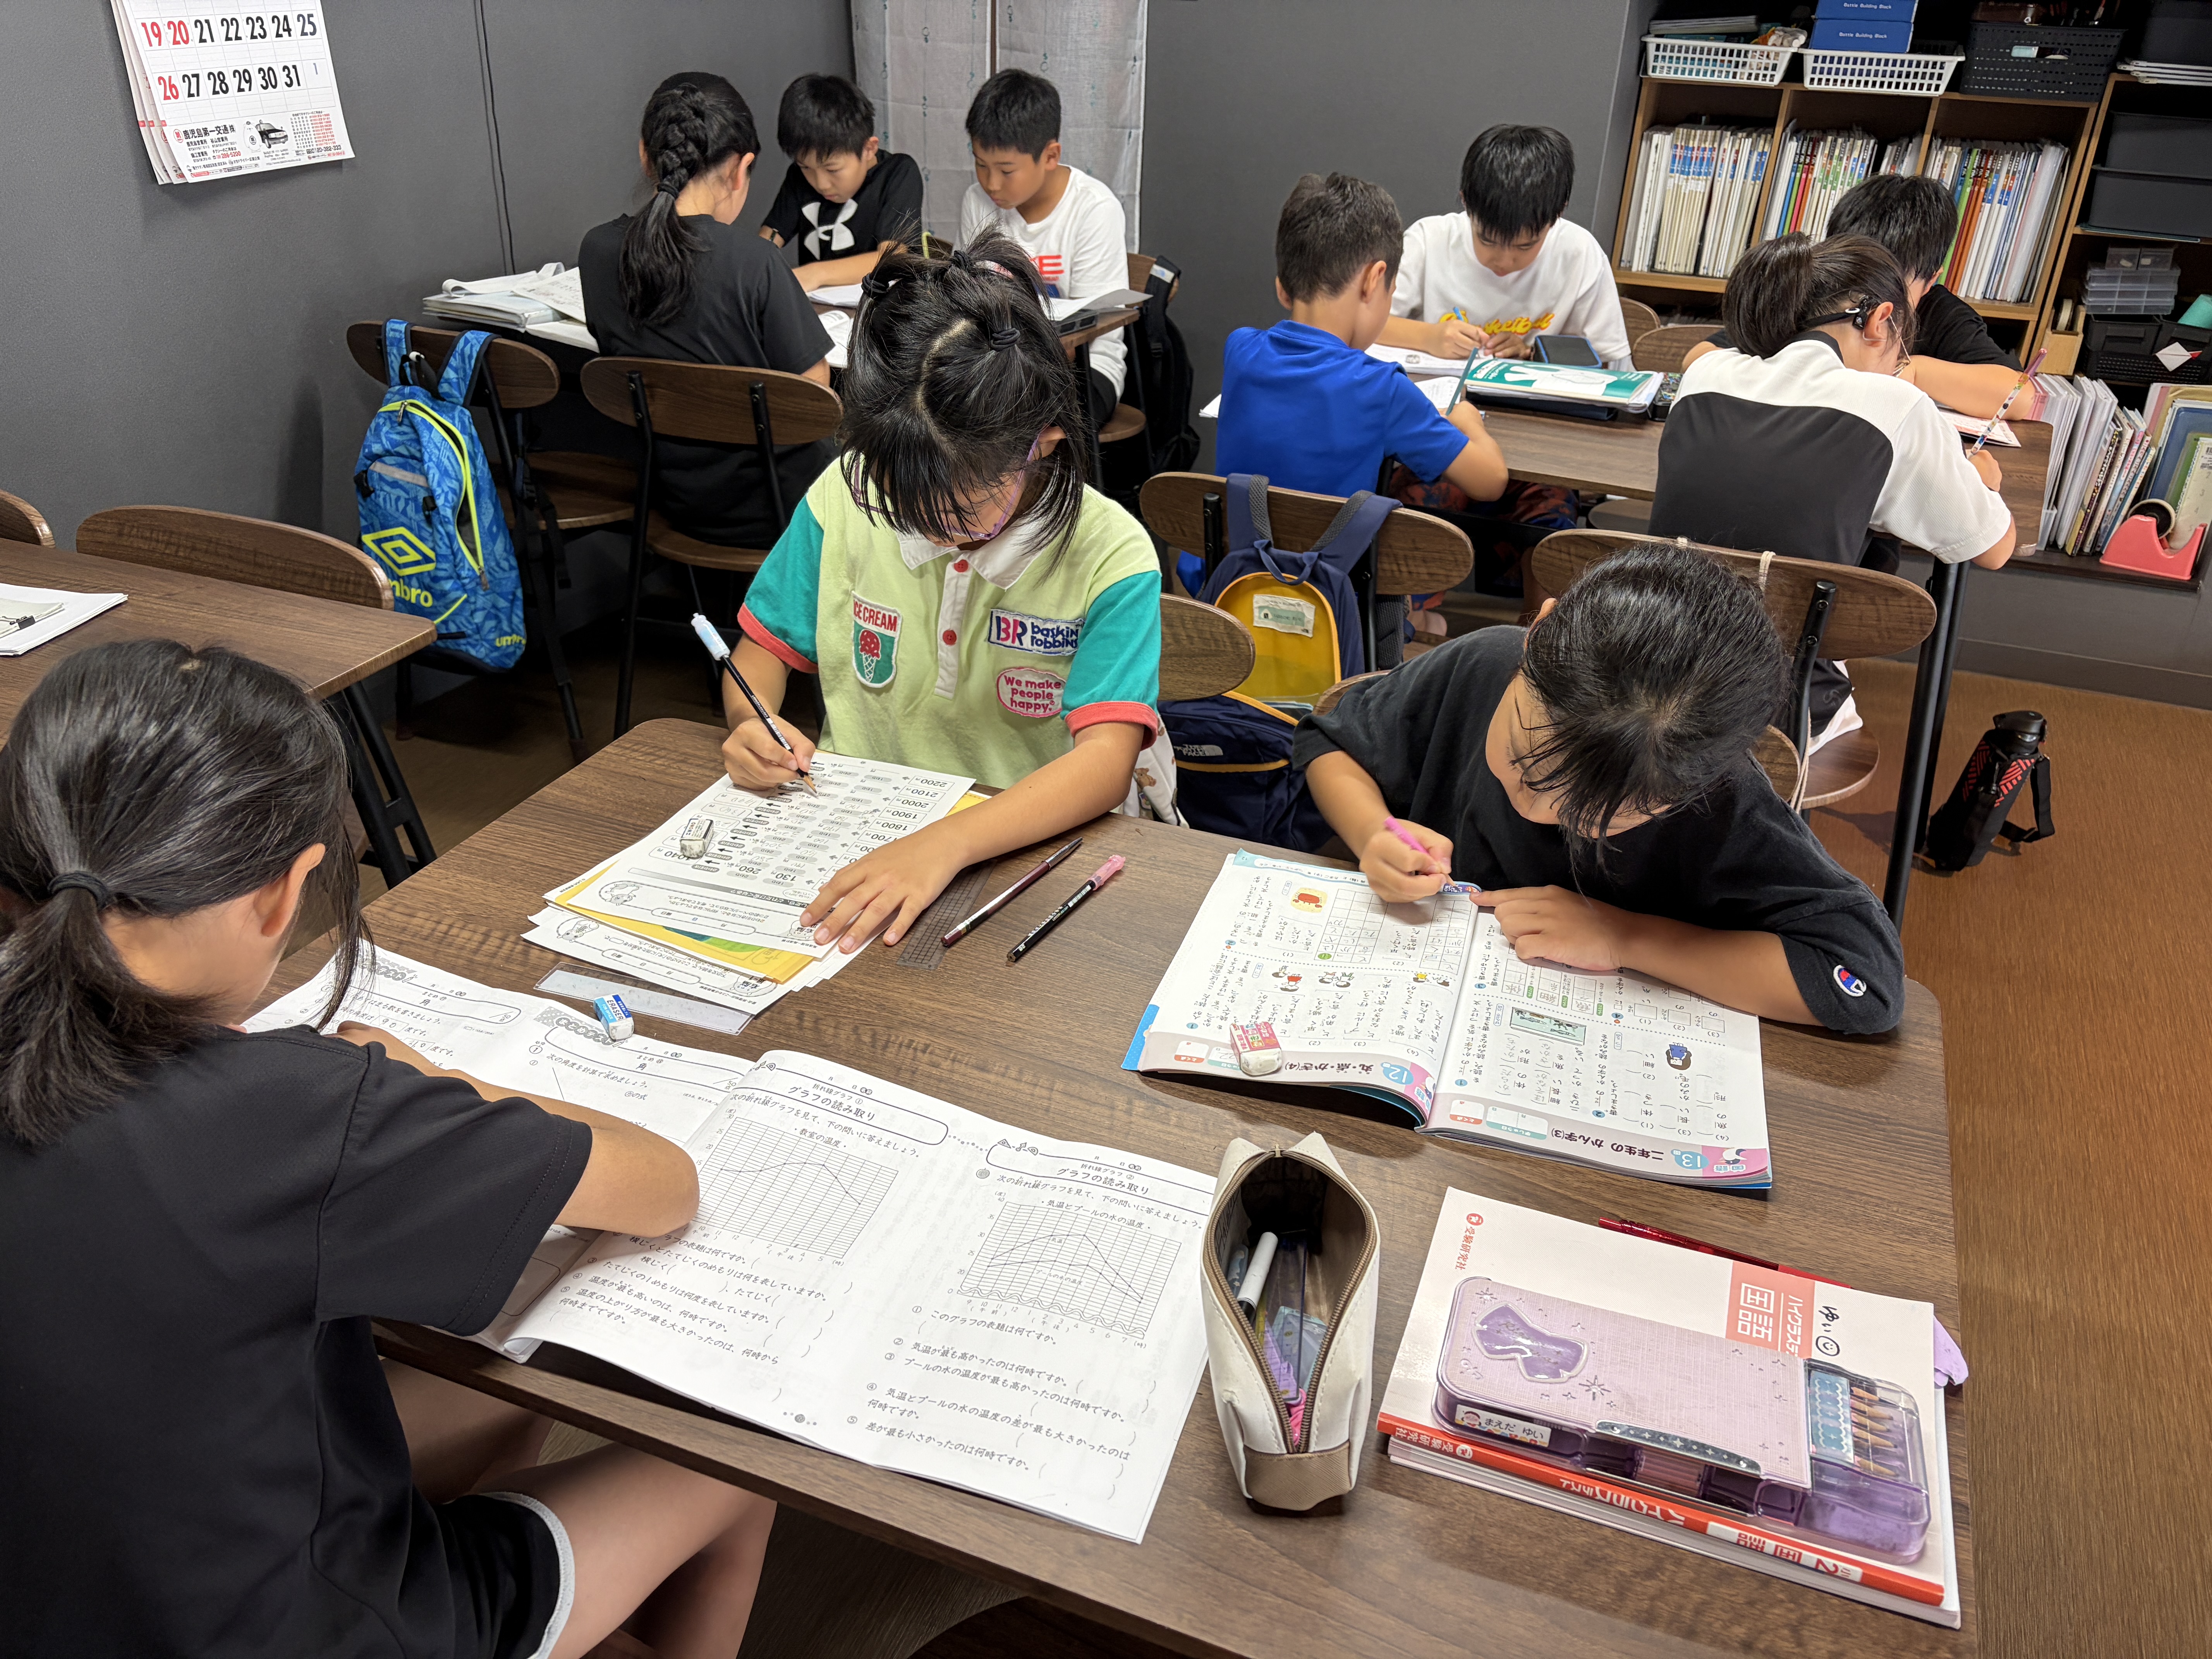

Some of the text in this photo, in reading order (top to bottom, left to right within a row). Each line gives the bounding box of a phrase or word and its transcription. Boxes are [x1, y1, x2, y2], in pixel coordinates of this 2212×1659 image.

[141, 14, 316, 46] 19 20 21 22 23 24 25
[158, 63, 318, 101] 26 27 28 29 30 31 1
[388, 577, 433, 607] mbro
[863, 606, 897, 632] CREAM
[1032, 621, 1077, 641] baskin
[1030, 635, 1077, 648] robbins
[1004, 675, 1061, 689] We make
[1011, 688, 1053, 701] people
[905, 787, 939, 798] 2100円
[915, 778, 948, 787] 2200円
[886, 809, 917, 819] 1900円
[896, 798, 929, 808] 2000円
[876, 821, 908, 831] 1800円
[735, 863, 763, 874] 260円
[770, 871, 798, 881] 130円
[668, 895, 769, 919] 2つ前のページにならって、考えてみましょう。
[669, 900, 765, 923] 2わり引きになると、何円になるでしょうか。
[606, 1000, 624, 1022] ERASER
[554, 1017, 615, 1046] まとめテスト
[1462, 1036, 1474, 1057] かん字に
[546, 1053, 647, 1088] 次の角度を計算で求めましょう。
[1387, 1066, 1409, 1082] 12
[788, 1085, 876, 1121] グラフの読み取り
[813, 1083, 853, 1100] 折れ線グラフ
[730, 1093, 919, 1158] 次の折れ線グラフを見て、下の問いに答えましょう。
[1550, 1128, 1664, 1160] 二年生の かん字(3)
[1080, 1163, 1122, 1177] 折れ線グラフ
[1680, 1153, 1702, 1168] 13
[1056, 1168, 1149, 1195] グラフの読み取り
[996, 1174, 1202, 1230] 次の折れ線グラフを見て、下の問いに答えましょう。
[665, 1234, 745, 1264] ラフの表題は何ですか。
[1455, 1226, 1475, 1271] 受験研究社
[629, 1236, 826, 1301] 横じくとたてじくのめもりは何を表していますか。
[1035, 1269, 1083, 1286] プールの水の温度
[588, 1275, 727, 1333] 温度が最も高いのは、何時ですか。
[603, 1261, 769, 1324] たてじくの1めもりは何度を表していますか。
[559, 1298, 625, 1324] 何時までですか。
[1736, 1282, 1775, 1342] 国語
[576, 1288, 778, 1365] 温度の上がり方が最も大きかったのは、何時から
[931, 1311, 1058, 1345] このグラフの表題は何ですか。
[912, 1341, 1068, 1387] 気温が最も高かったのは何時ですか。
[904, 1357, 1126, 1423] プールの水の温度が最も高かったのは何時ですか。
[867, 1398, 920, 1419] 何時ですか。
[885, 1387, 1131, 1461] 気温とプールの水の温度の差が最も大きかったのは
[1484, 1417, 1544, 1440] まえだ ゆい
[865, 1421, 1029, 1471] 差が最も小さかったのは何時ですか。
[1395, 1427, 1454, 1453] 受験研究社
[1560, 1478, 1686, 1526] ハイクラステスト
[1736, 1531, 1802, 1563] 国語
